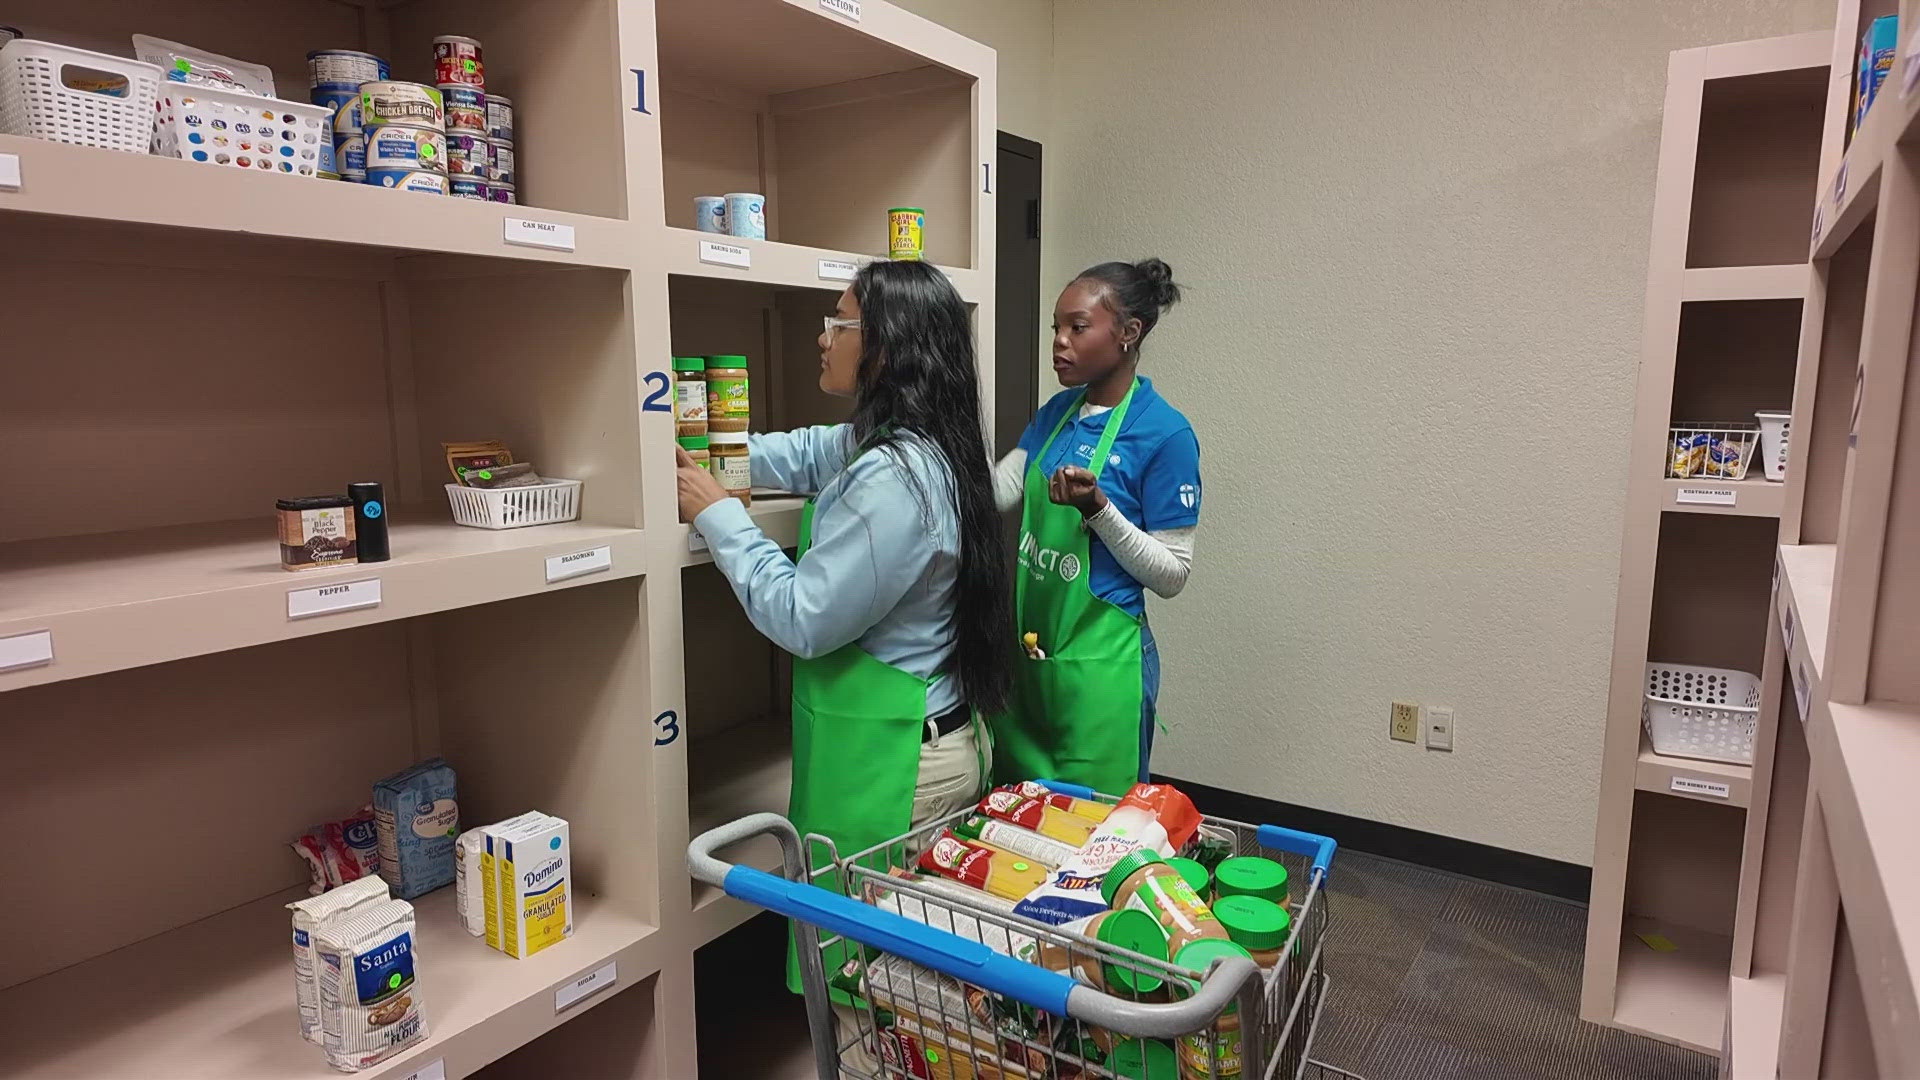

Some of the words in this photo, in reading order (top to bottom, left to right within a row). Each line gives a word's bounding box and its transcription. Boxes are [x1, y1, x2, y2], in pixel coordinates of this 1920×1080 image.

[822, 0, 854, 13] CTION
[630, 68, 652, 116] 1
[375, 104, 407, 117] CHICKEN
[409, 105, 435, 118] BREAST
[411, 179, 440, 188] CRIDER
[981, 162, 992, 194] 1
[522, 221, 536, 230] CAN
[710, 244, 729, 253] BAKING
[642, 371, 672, 413] 2
[313, 519, 335, 528] Black
[311, 527, 337, 535] Pepper
[561, 550, 595, 564] SEASONING
[318, 585, 350, 597] PEPPER
[653, 709, 680, 748] 3
[416, 806, 456, 826] Granulated
[437, 815, 456, 828] Sugar
[523, 857, 563, 888] Domino
[523, 893, 567, 920] GRANULATED
[536, 908, 556, 922] SUGAR
[360, 941, 408, 972] Santa
[577, 973, 596, 988] SUGAR
[390, 1022, 421, 1046] FLOUR
[1193, 1055, 1240, 1068] CRAMY
